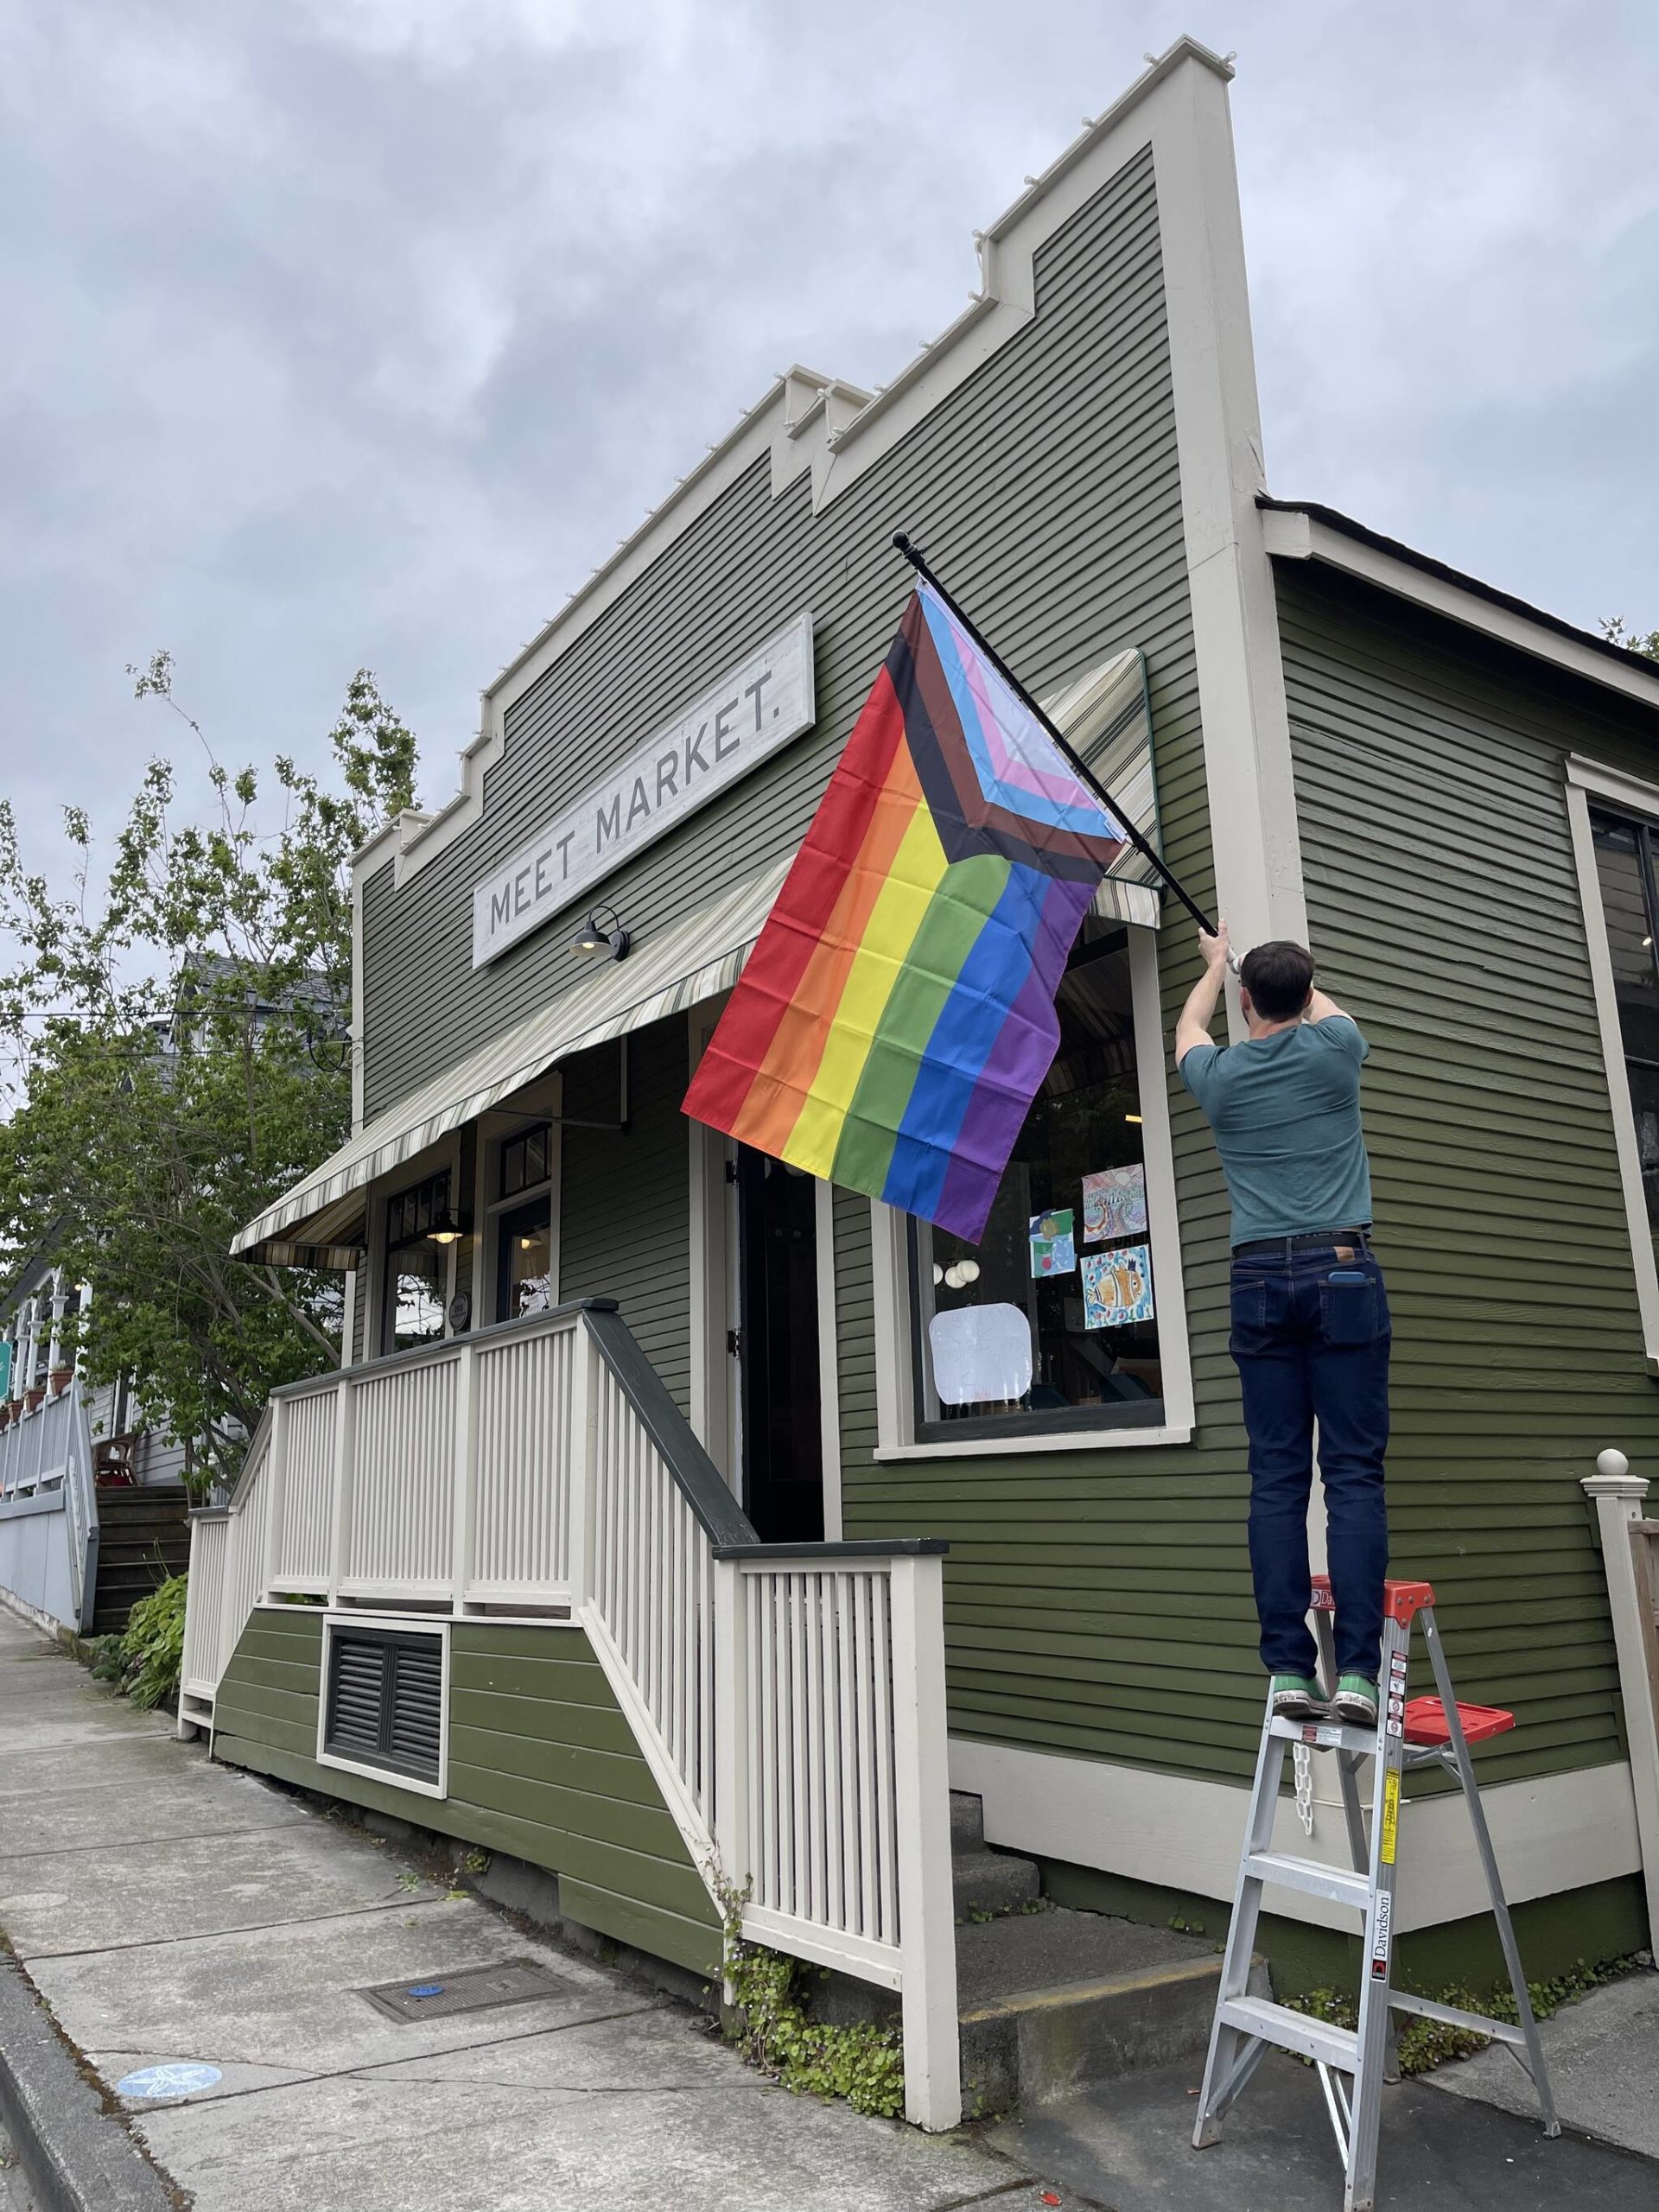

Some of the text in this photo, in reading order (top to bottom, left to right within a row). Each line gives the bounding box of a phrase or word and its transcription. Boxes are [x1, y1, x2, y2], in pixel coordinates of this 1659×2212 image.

[491, 670, 780, 935] MEET MARKET.
[1375, 1897, 1389, 1957] Davidson
